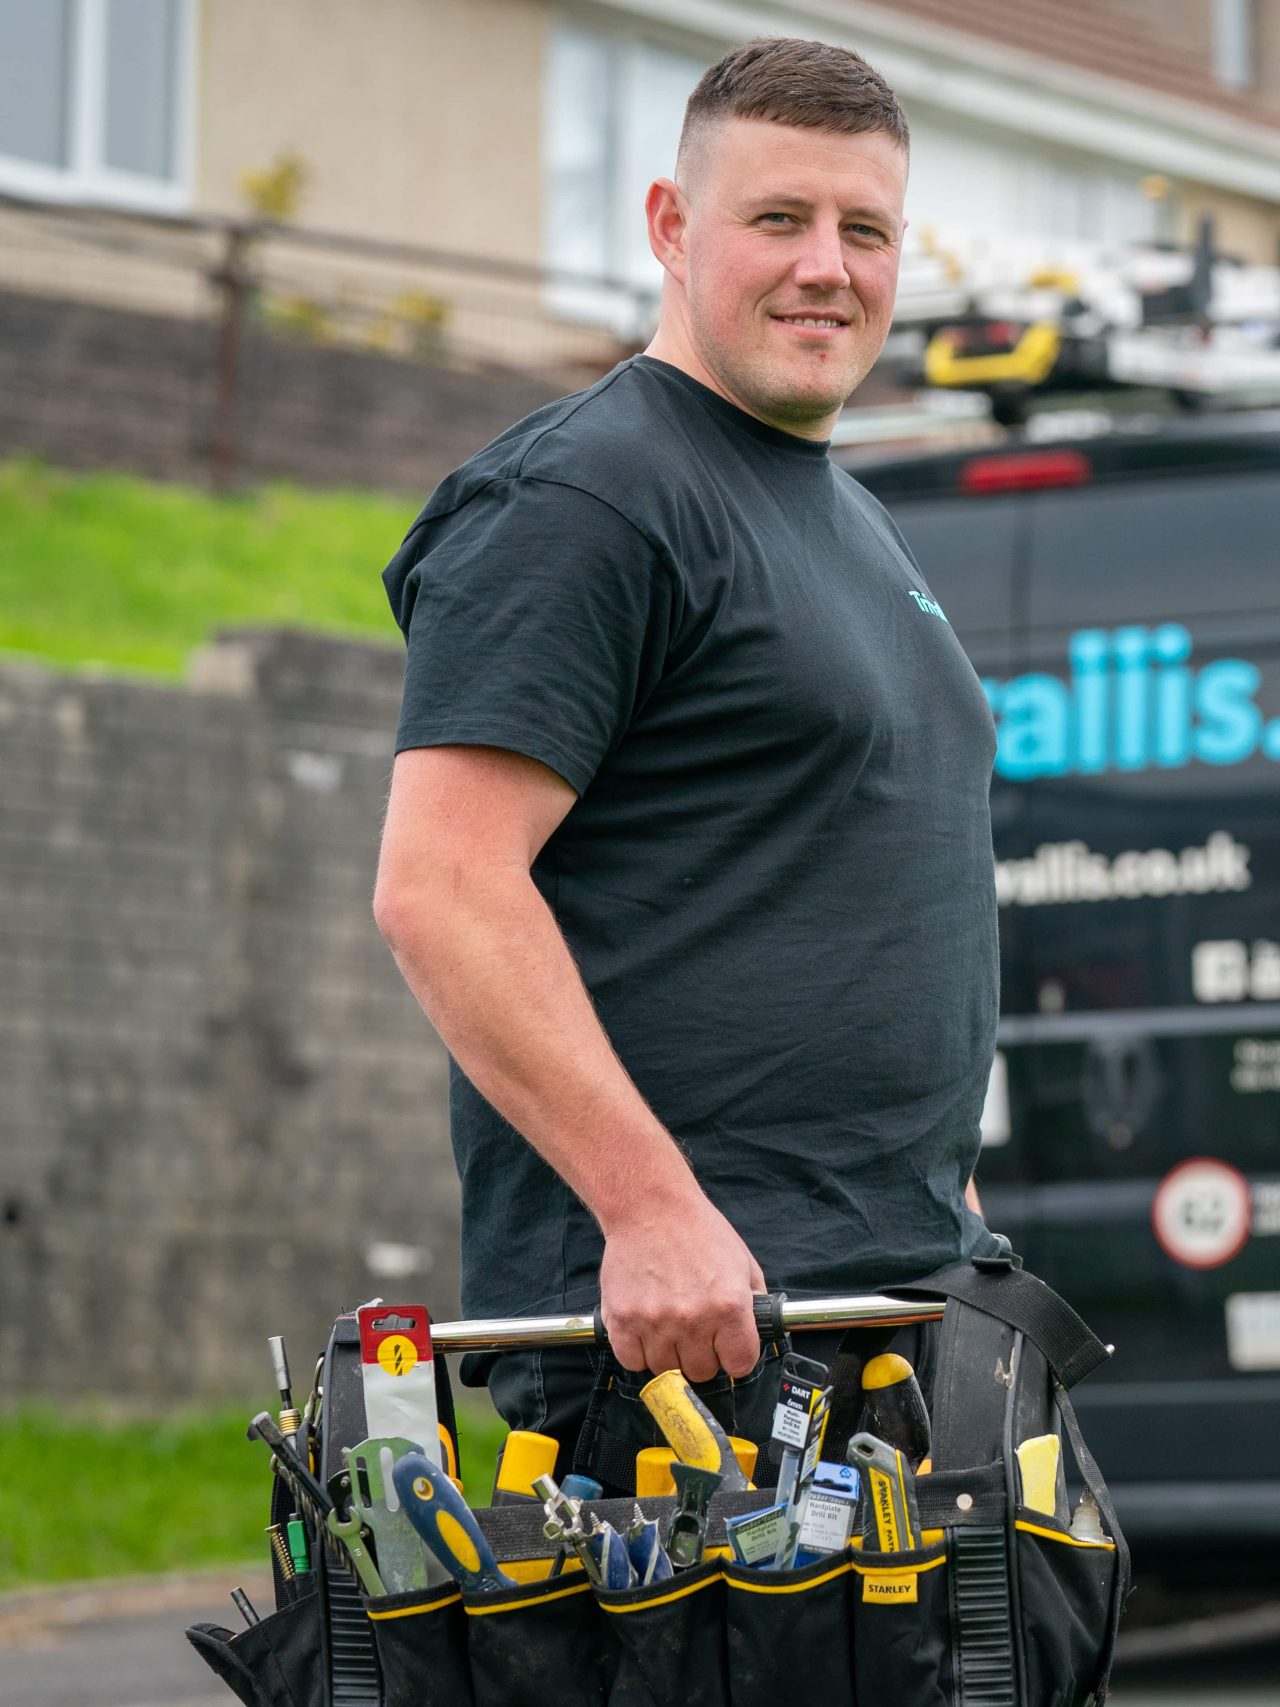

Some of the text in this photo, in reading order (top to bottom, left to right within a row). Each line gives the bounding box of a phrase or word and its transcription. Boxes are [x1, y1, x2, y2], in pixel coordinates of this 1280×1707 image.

[791, 1385, 811, 1400] DART
[787, 1398, 803, 1411] 6mm
[809, 1501, 842, 1513] Hardplate
[878, 1480, 893, 1525] STANLEY
[811, 1509, 838, 1521] Drill Bit
[746, 1521, 777, 1537] Hardplate
[751, 1532, 766, 1542] Drill
[868, 1584, 911, 1594] STANLEY
